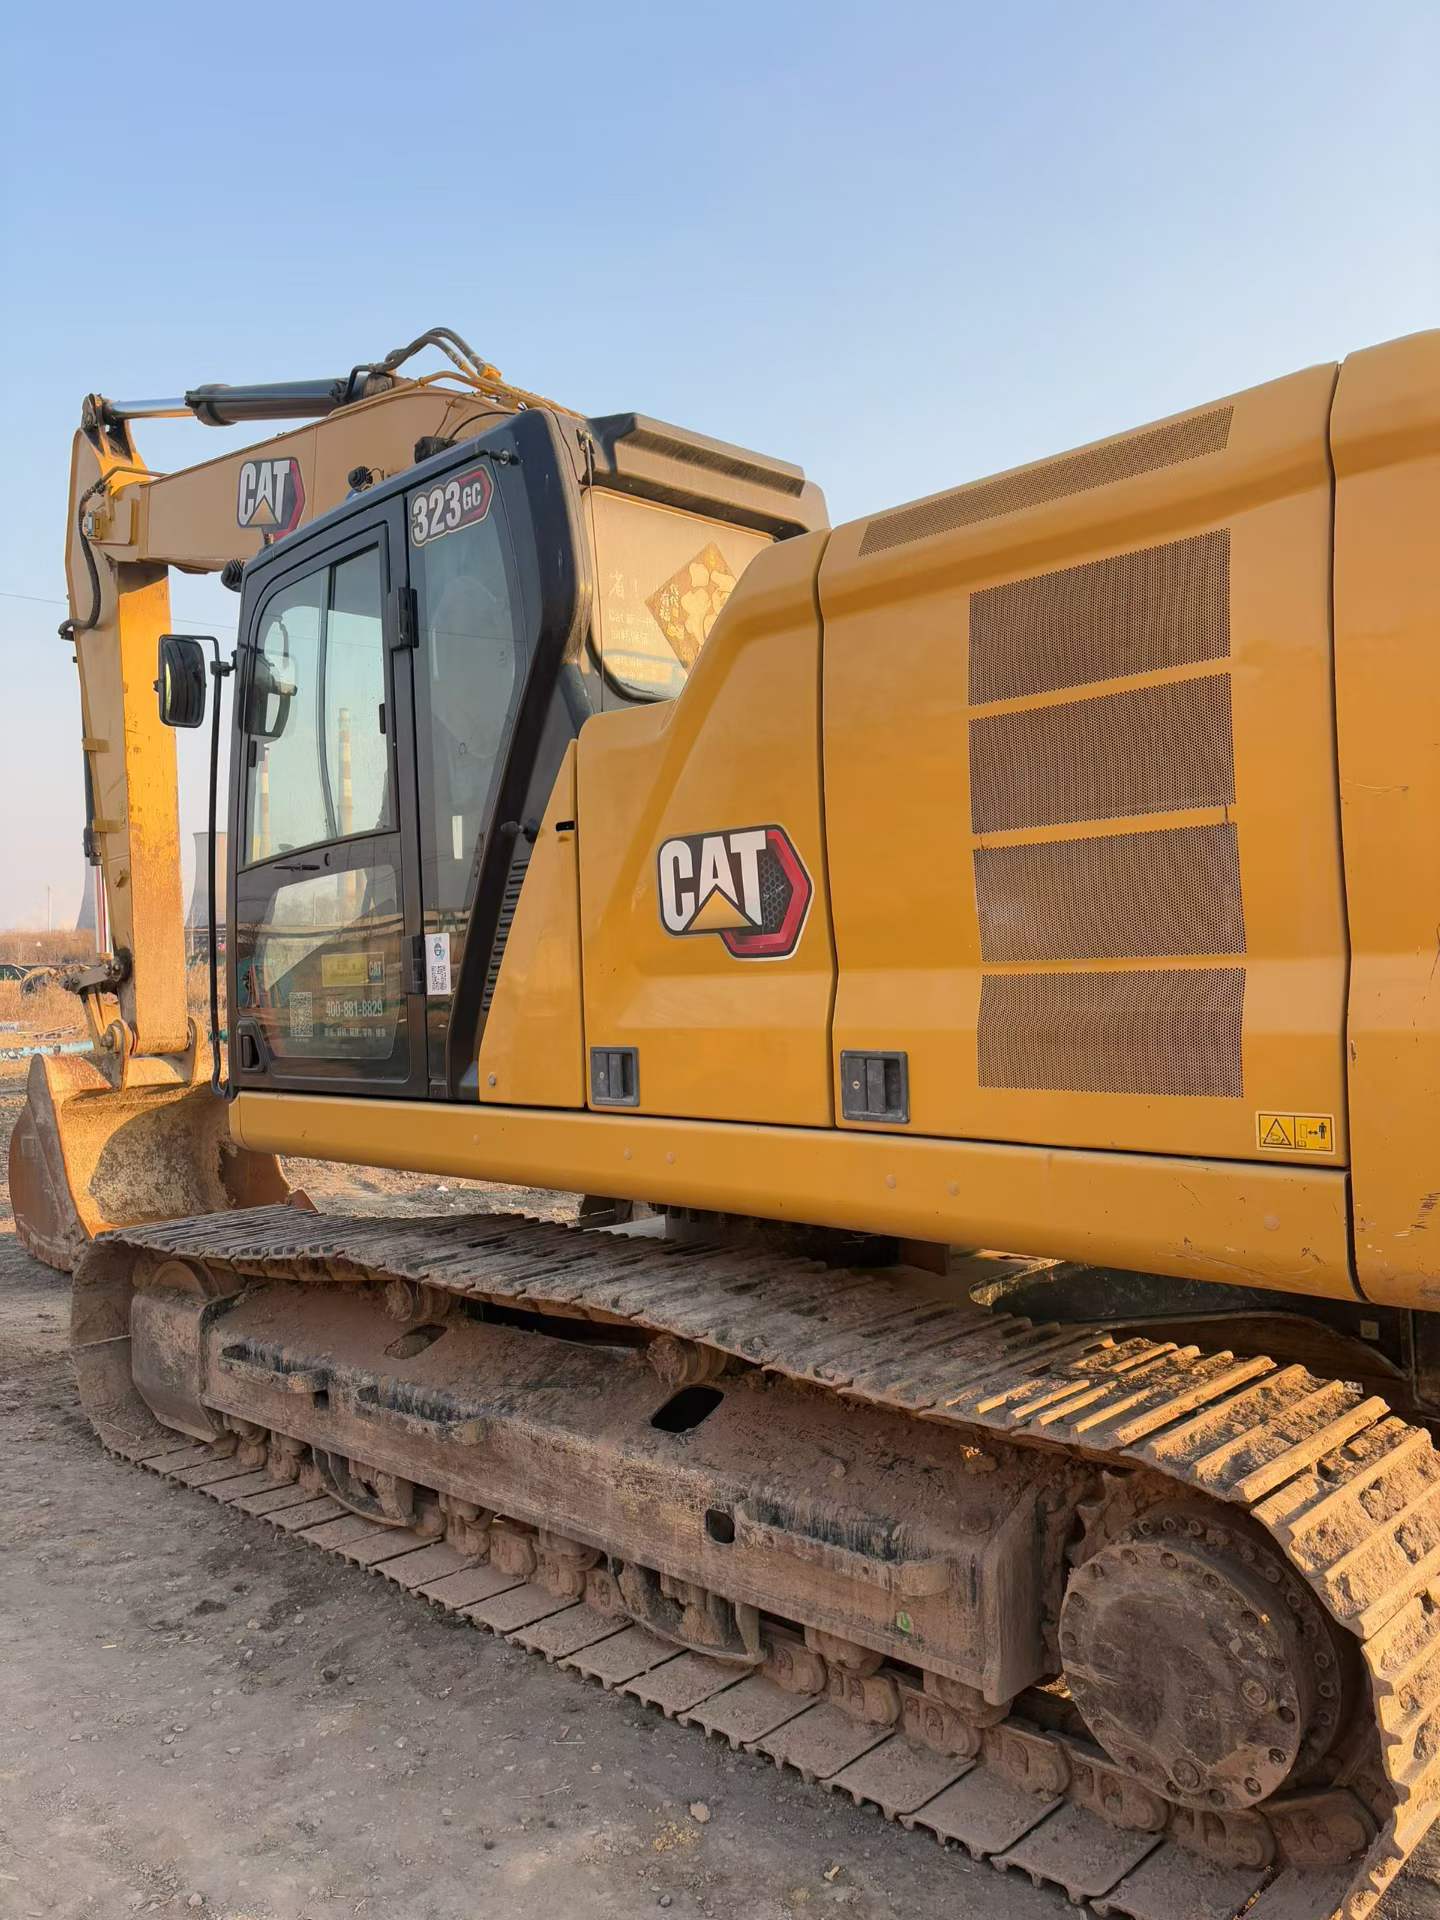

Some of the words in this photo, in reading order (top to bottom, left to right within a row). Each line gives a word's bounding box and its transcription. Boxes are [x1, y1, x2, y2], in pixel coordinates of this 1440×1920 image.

[239, 459, 291, 526] CAT
[413, 481, 462, 541] 323
[462, 482, 481, 511] GC
[659, 829, 768, 932] CAT
[326, 1000, 383, 1017] 400-881-8829
